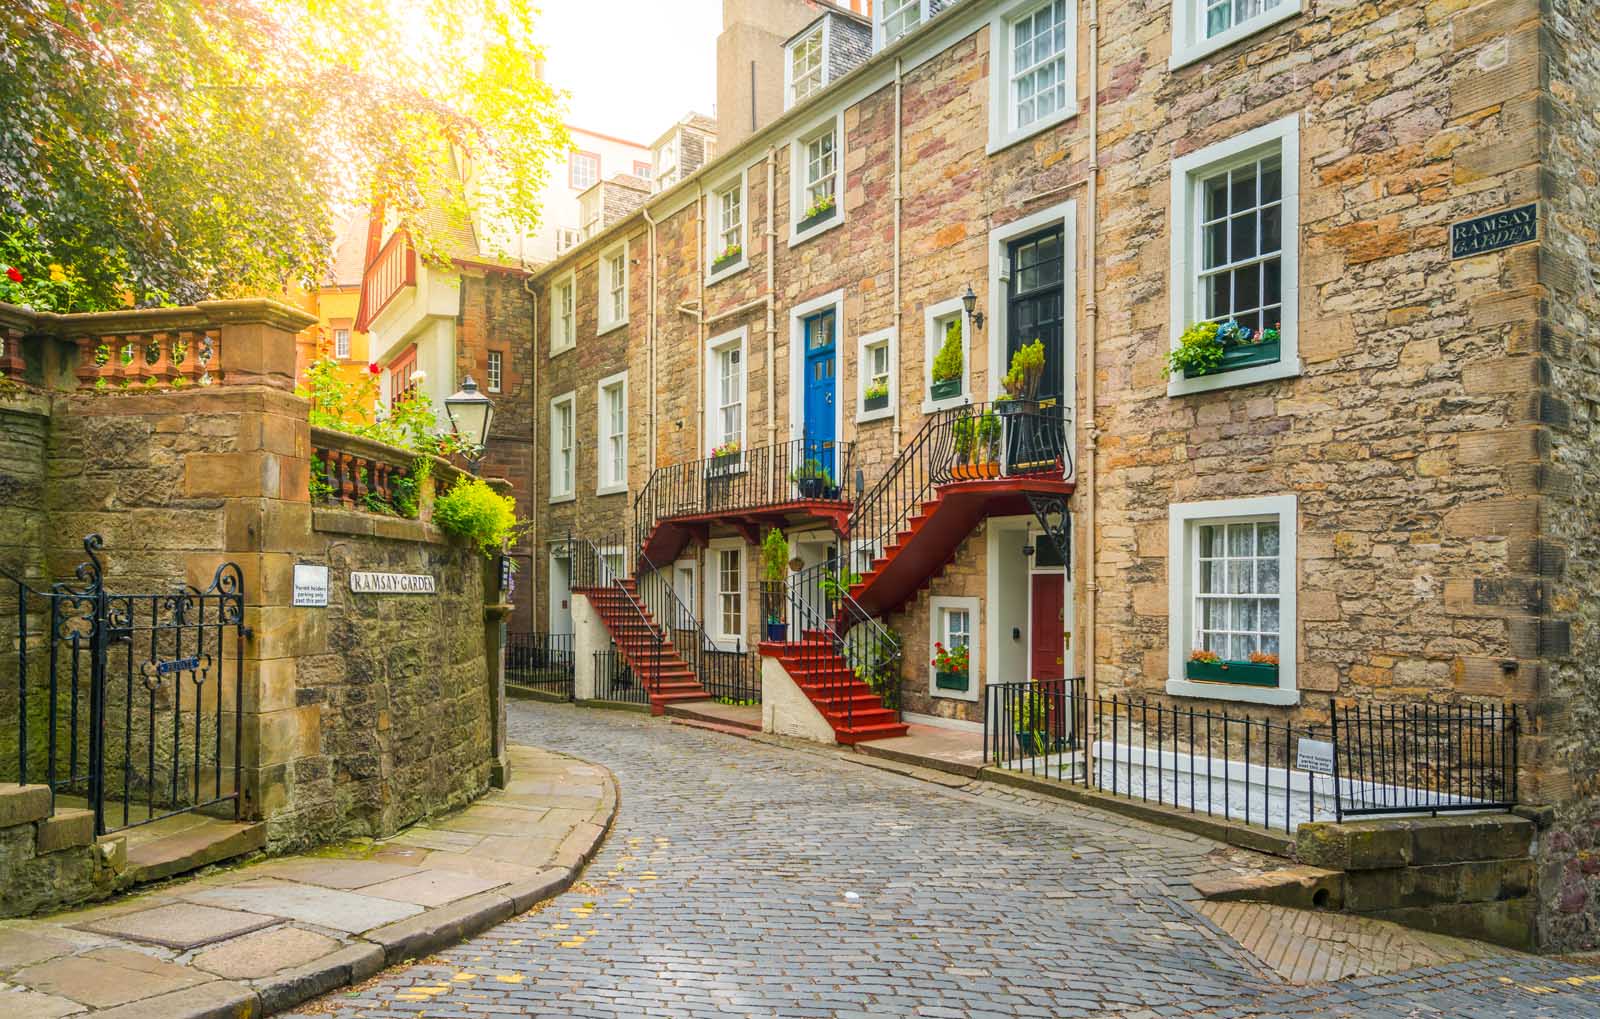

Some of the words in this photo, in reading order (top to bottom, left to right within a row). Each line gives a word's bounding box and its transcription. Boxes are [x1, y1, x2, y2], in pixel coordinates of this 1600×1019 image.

[1454, 220, 1537, 254] GARDEN
[1455, 208, 1532, 240] RAMSAY
[354, 573, 397, 590] RAMSAY
[400, 575, 434, 591] GARDEN
